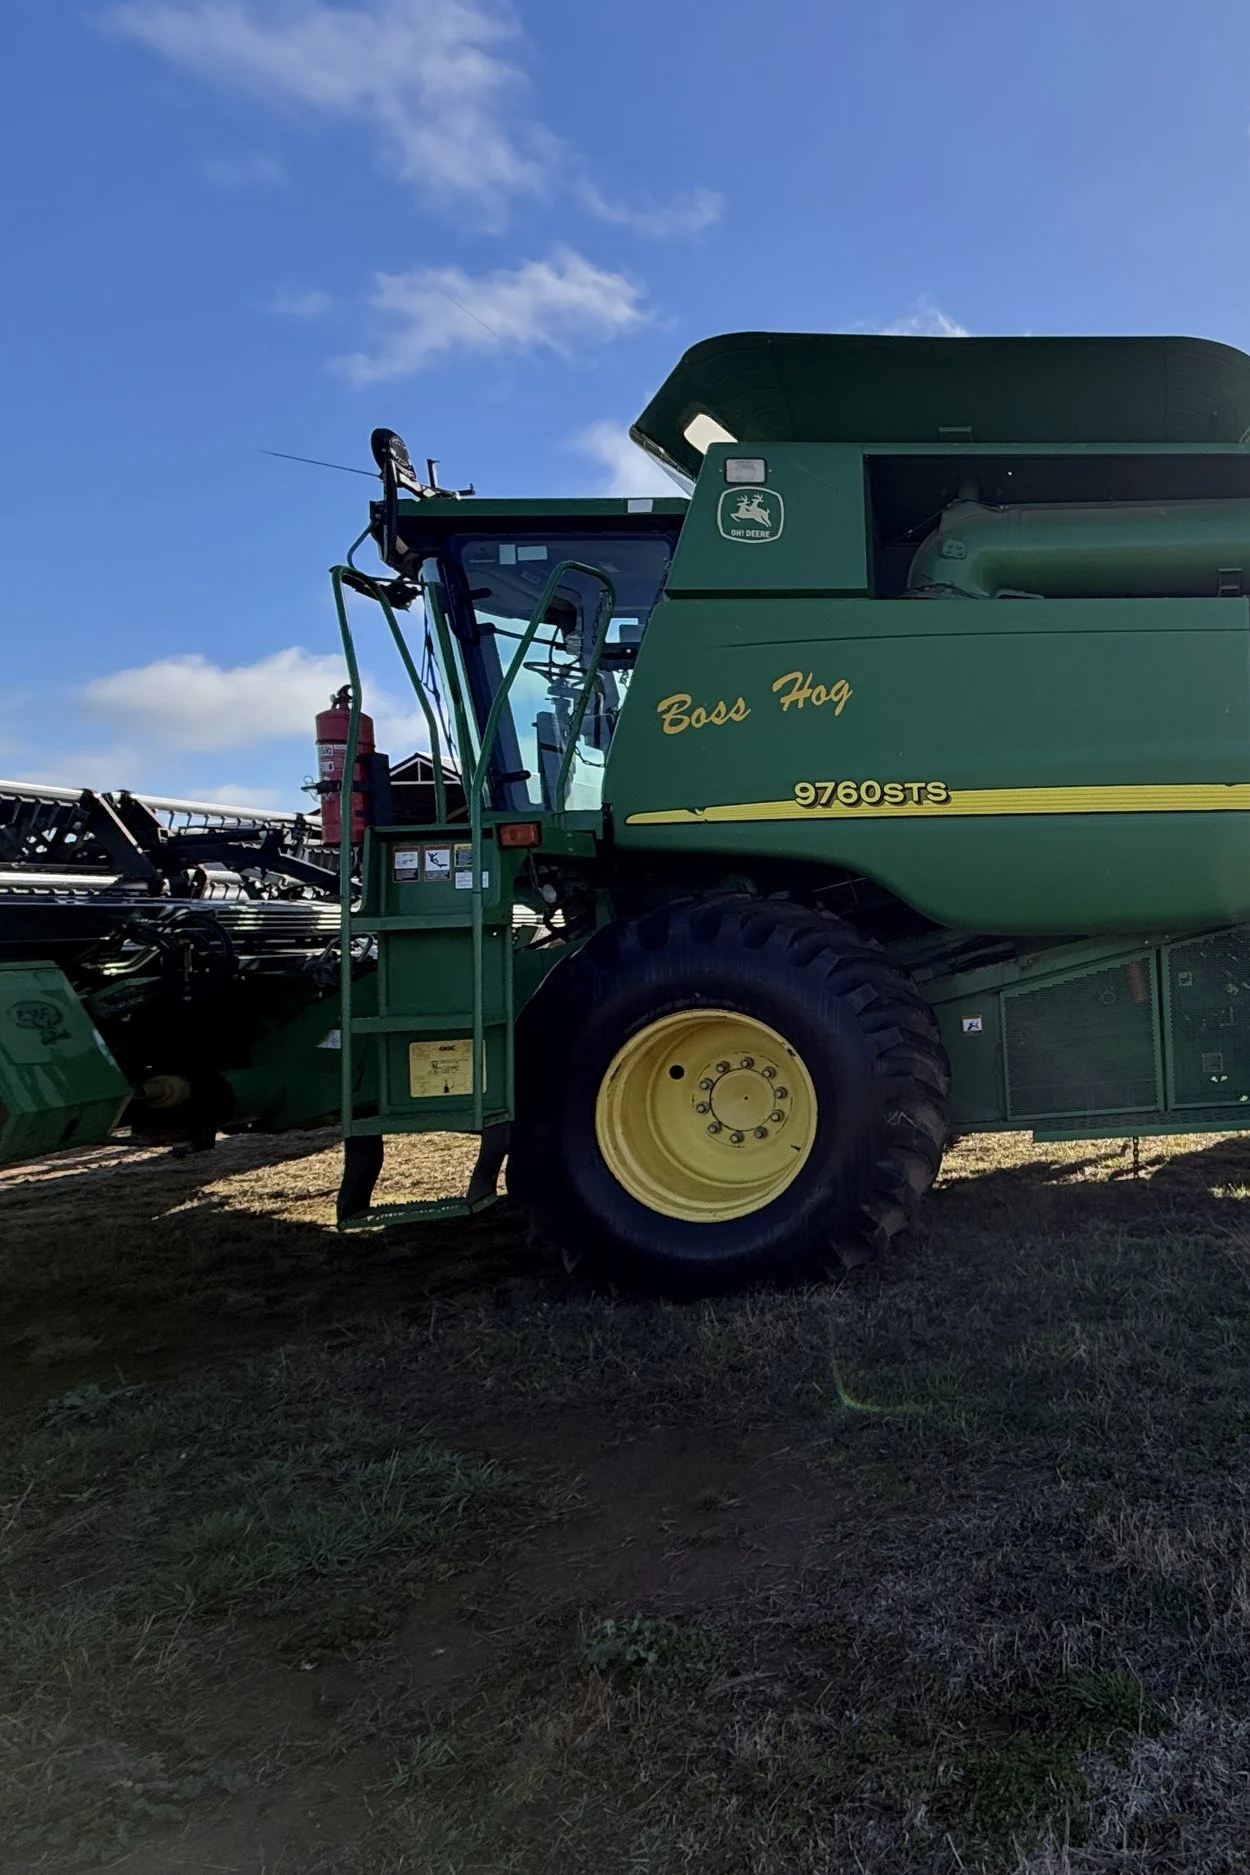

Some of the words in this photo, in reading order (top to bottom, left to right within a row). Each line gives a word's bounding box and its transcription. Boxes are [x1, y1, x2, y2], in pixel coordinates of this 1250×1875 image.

[745, 529, 771, 538] DEERE
[657, 693, 751, 735] Boss
[771, 671, 853, 717] Hog
[793, 779, 951, 809] 9760STS
